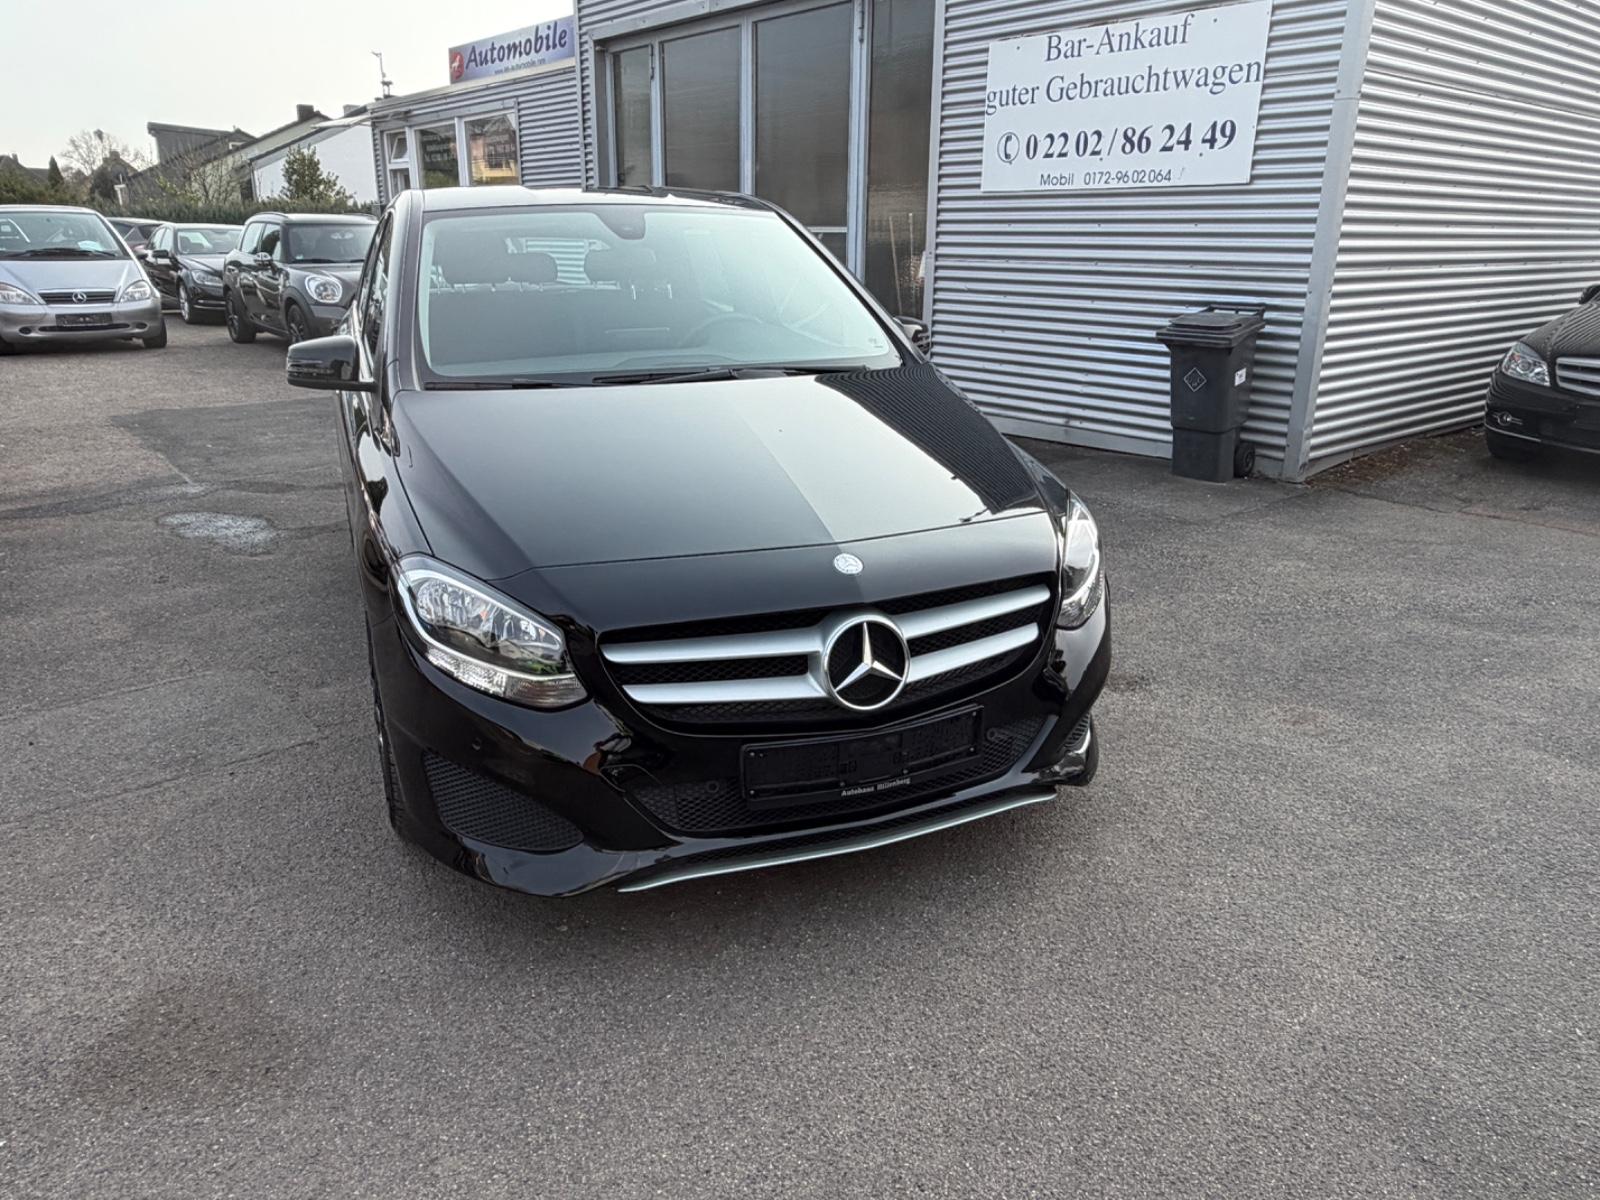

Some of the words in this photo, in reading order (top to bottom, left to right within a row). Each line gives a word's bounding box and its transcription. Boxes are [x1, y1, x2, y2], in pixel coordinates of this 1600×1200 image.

[465, 20, 568, 70] Automobile
[1044, 13, 1195, 62] Bar-Ankauf
[985, 84, 1040, 116] guter
[1046, 60, 1262, 103] Gebrauchtwagen
[1040, 172, 1075, 187] Mobil
[1084, 168, 1172, 186] 0172-9602064
[840, 786, 874, 797] Autohaus
